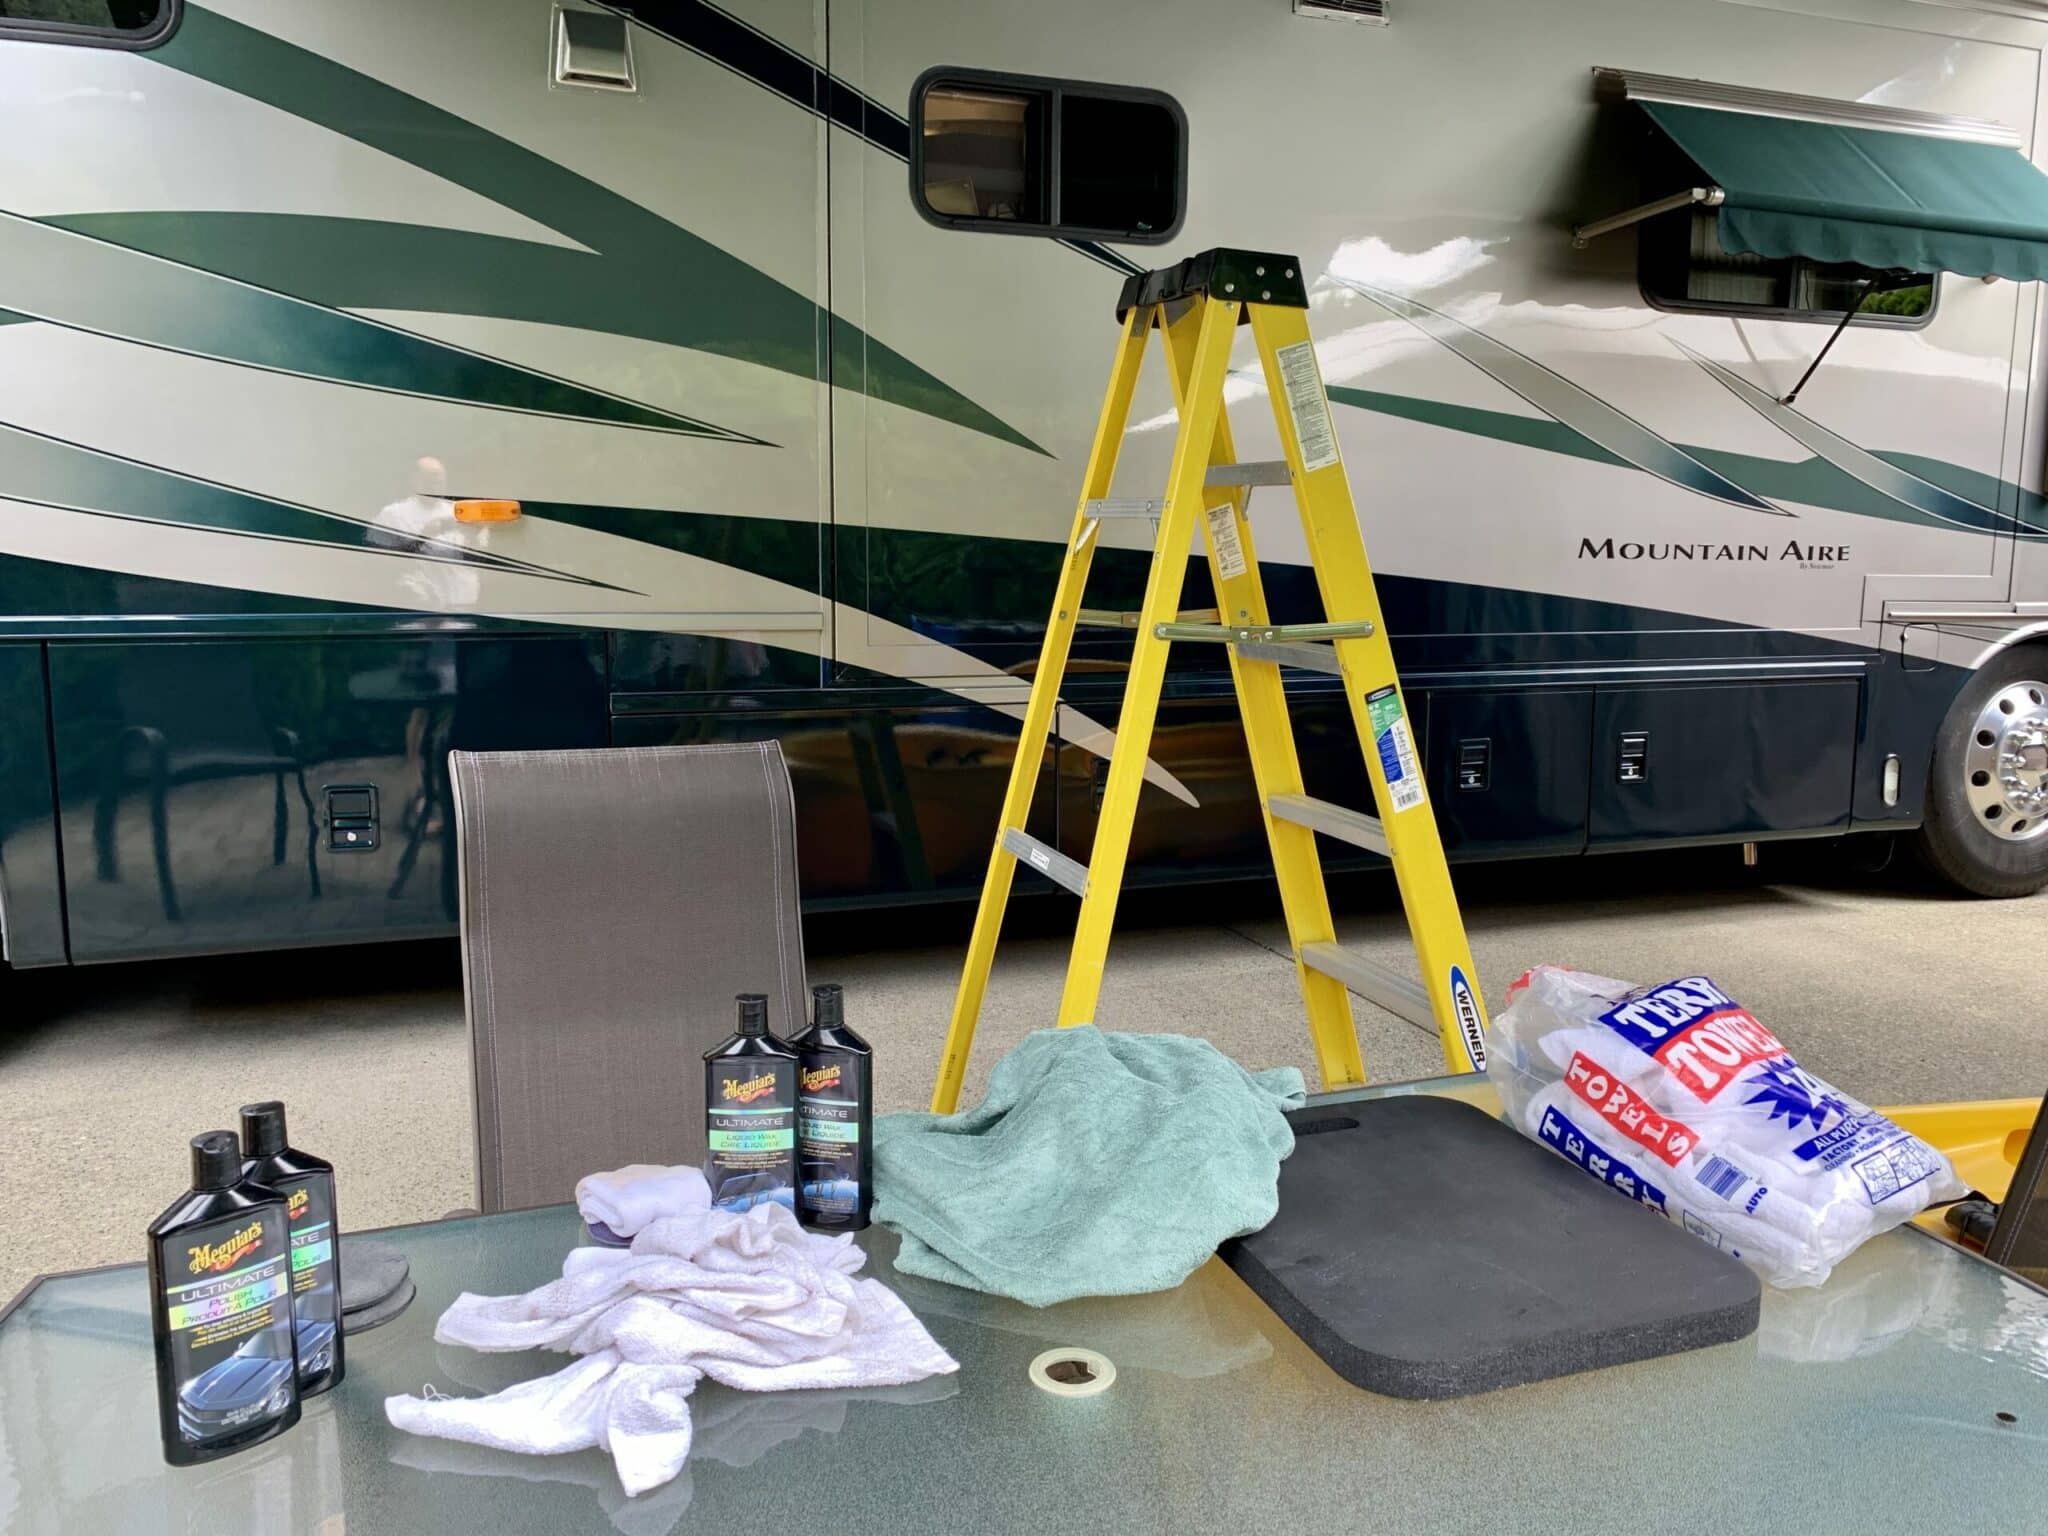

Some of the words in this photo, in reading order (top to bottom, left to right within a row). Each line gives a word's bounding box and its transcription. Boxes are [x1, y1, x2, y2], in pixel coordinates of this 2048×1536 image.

[1578, 537, 1768, 561] MOUNTAIN
[1780, 540, 1849, 561] AIRE
[1613, 977, 1730, 1039] TERR
[1457, 990, 1485, 1063] WERNER
[1665, 1015, 1780, 1089] TOWEL
[722, 1072, 776, 1101] Meguiar's
[716, 1117, 784, 1127] ULTIMATE
[802, 1105, 848, 1118] TIMATE
[1568, 1058, 1692, 1157] TOWELS
[1814, 1132, 1836, 1151] ALL
[1822, 1138, 1861, 1162] FACTORY
[1745, 1187, 1768, 1214] AUTO
[187, 1221, 264, 1275] Meguiar's
[181, 1265, 275, 1302] ULTIMATE
